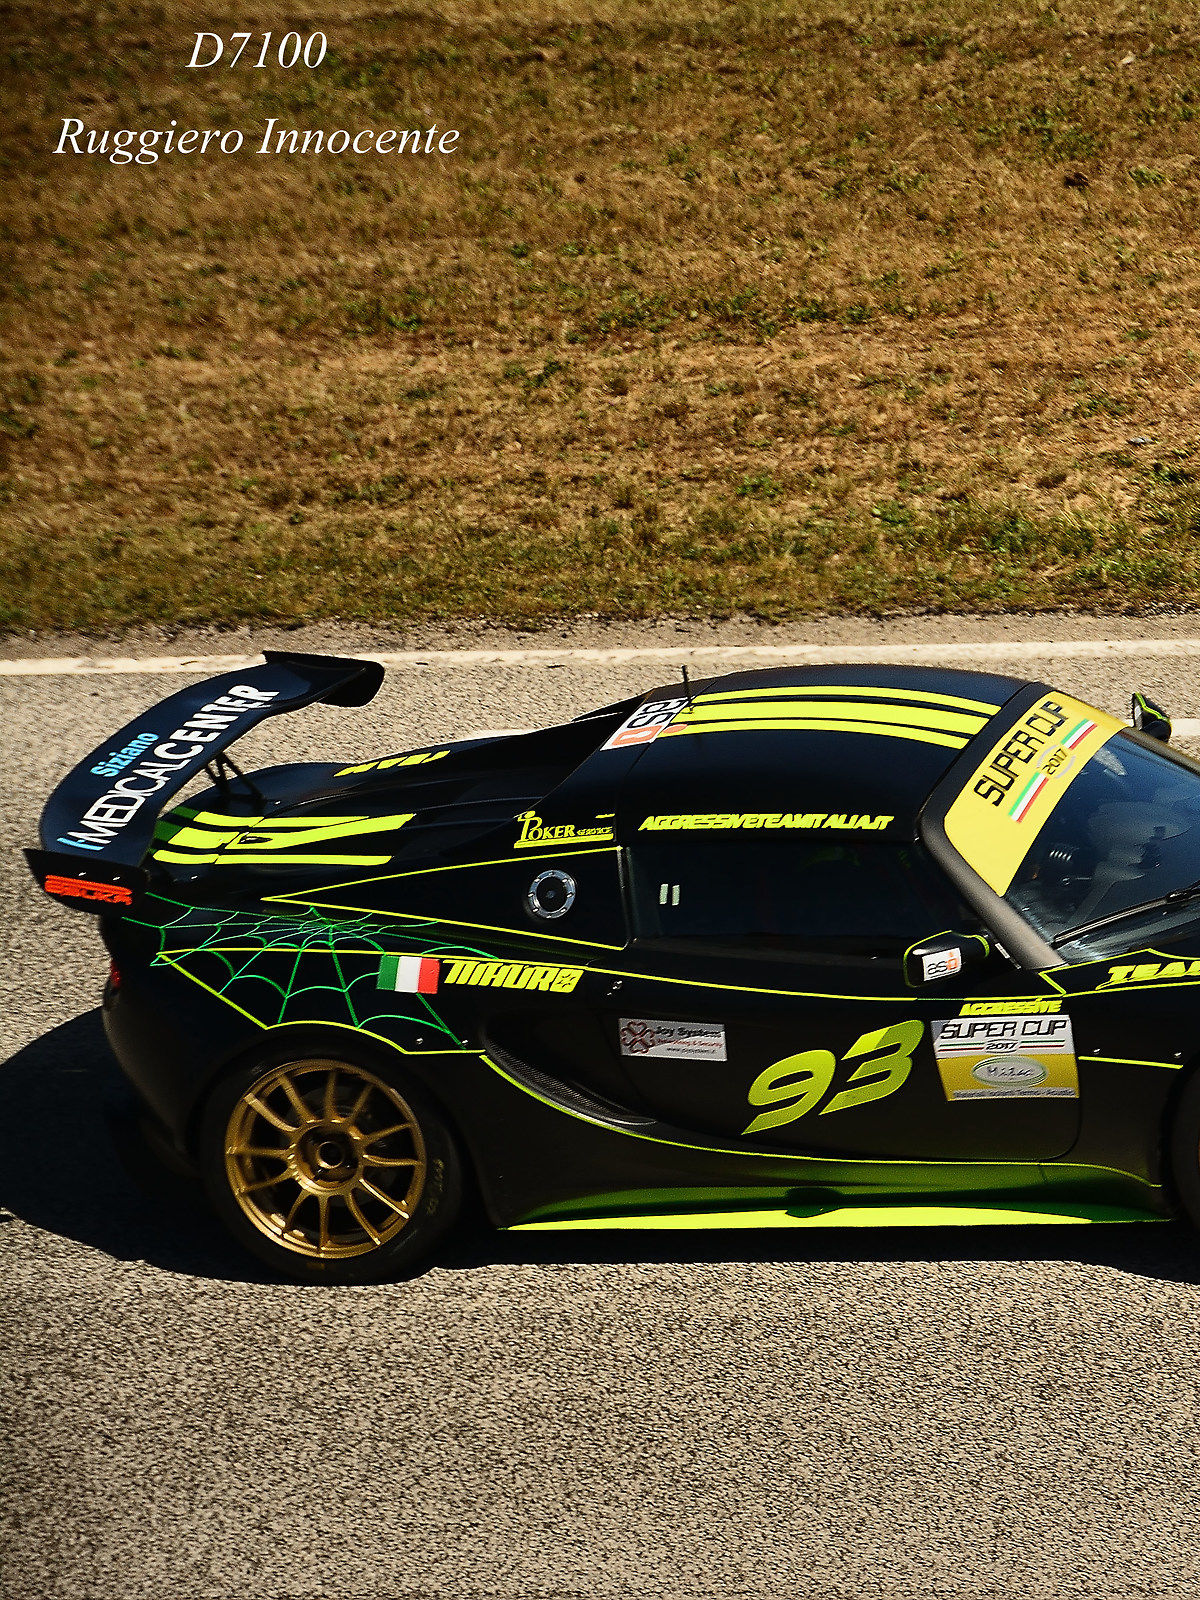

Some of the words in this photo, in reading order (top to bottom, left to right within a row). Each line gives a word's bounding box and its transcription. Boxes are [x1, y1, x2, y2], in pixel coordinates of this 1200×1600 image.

[153, 684, 280, 760] CENTER
[90, 732, 159, 778] Siziano
[974, 730, 1045, 807] SUPER
[1026, 701, 1069, 737] CUP
[1042, 748, 1067, 775] 2017
[941, 1021, 1017, 1039] SUPER
[1021, 1019, 1068, 1036] CUP
[985, 1041, 1018, 1050] 2017
[741, 1019, 925, 1135] 93
